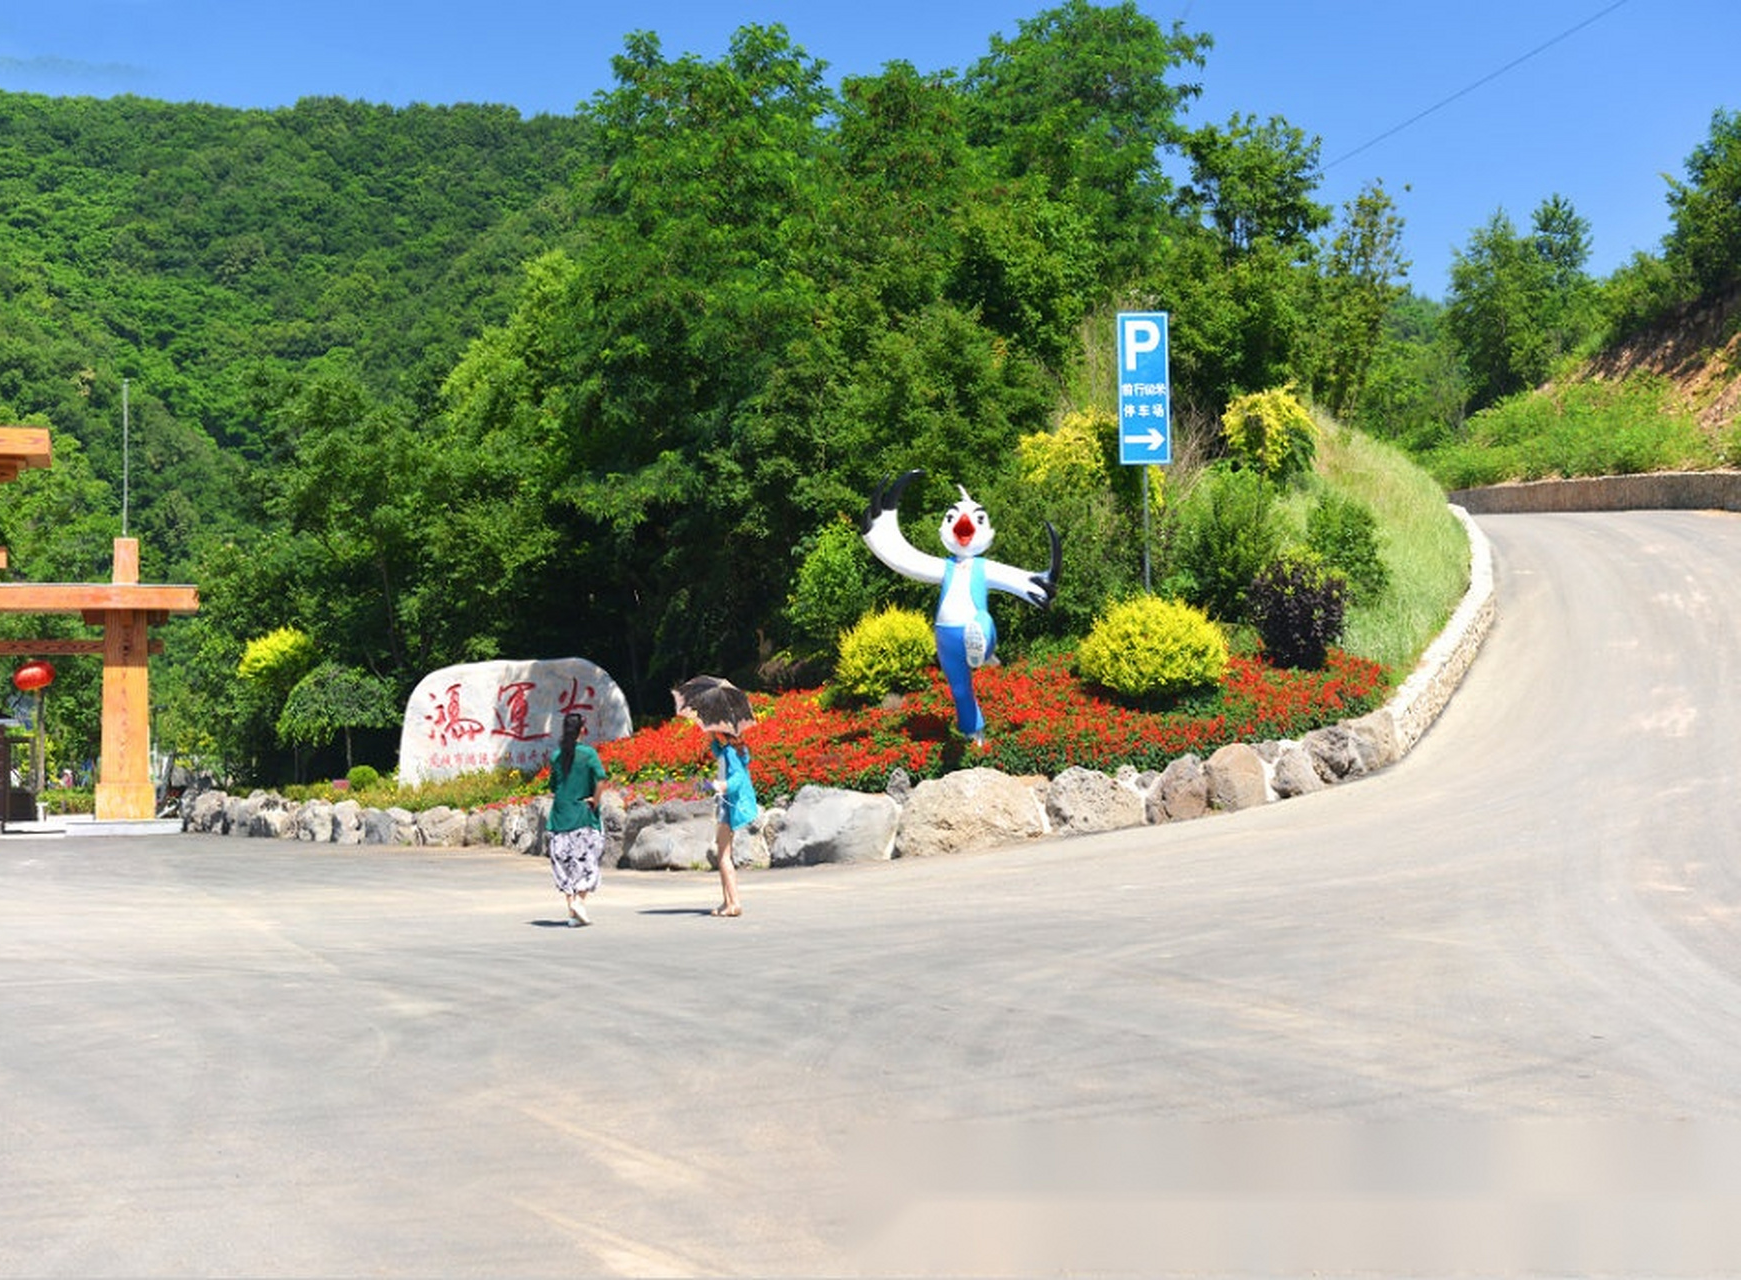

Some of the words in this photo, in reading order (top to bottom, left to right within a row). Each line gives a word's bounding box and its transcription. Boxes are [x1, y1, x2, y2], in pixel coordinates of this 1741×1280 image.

[1125, 320, 1161, 371] P
[1124, 403, 1165, 418] 停车场
